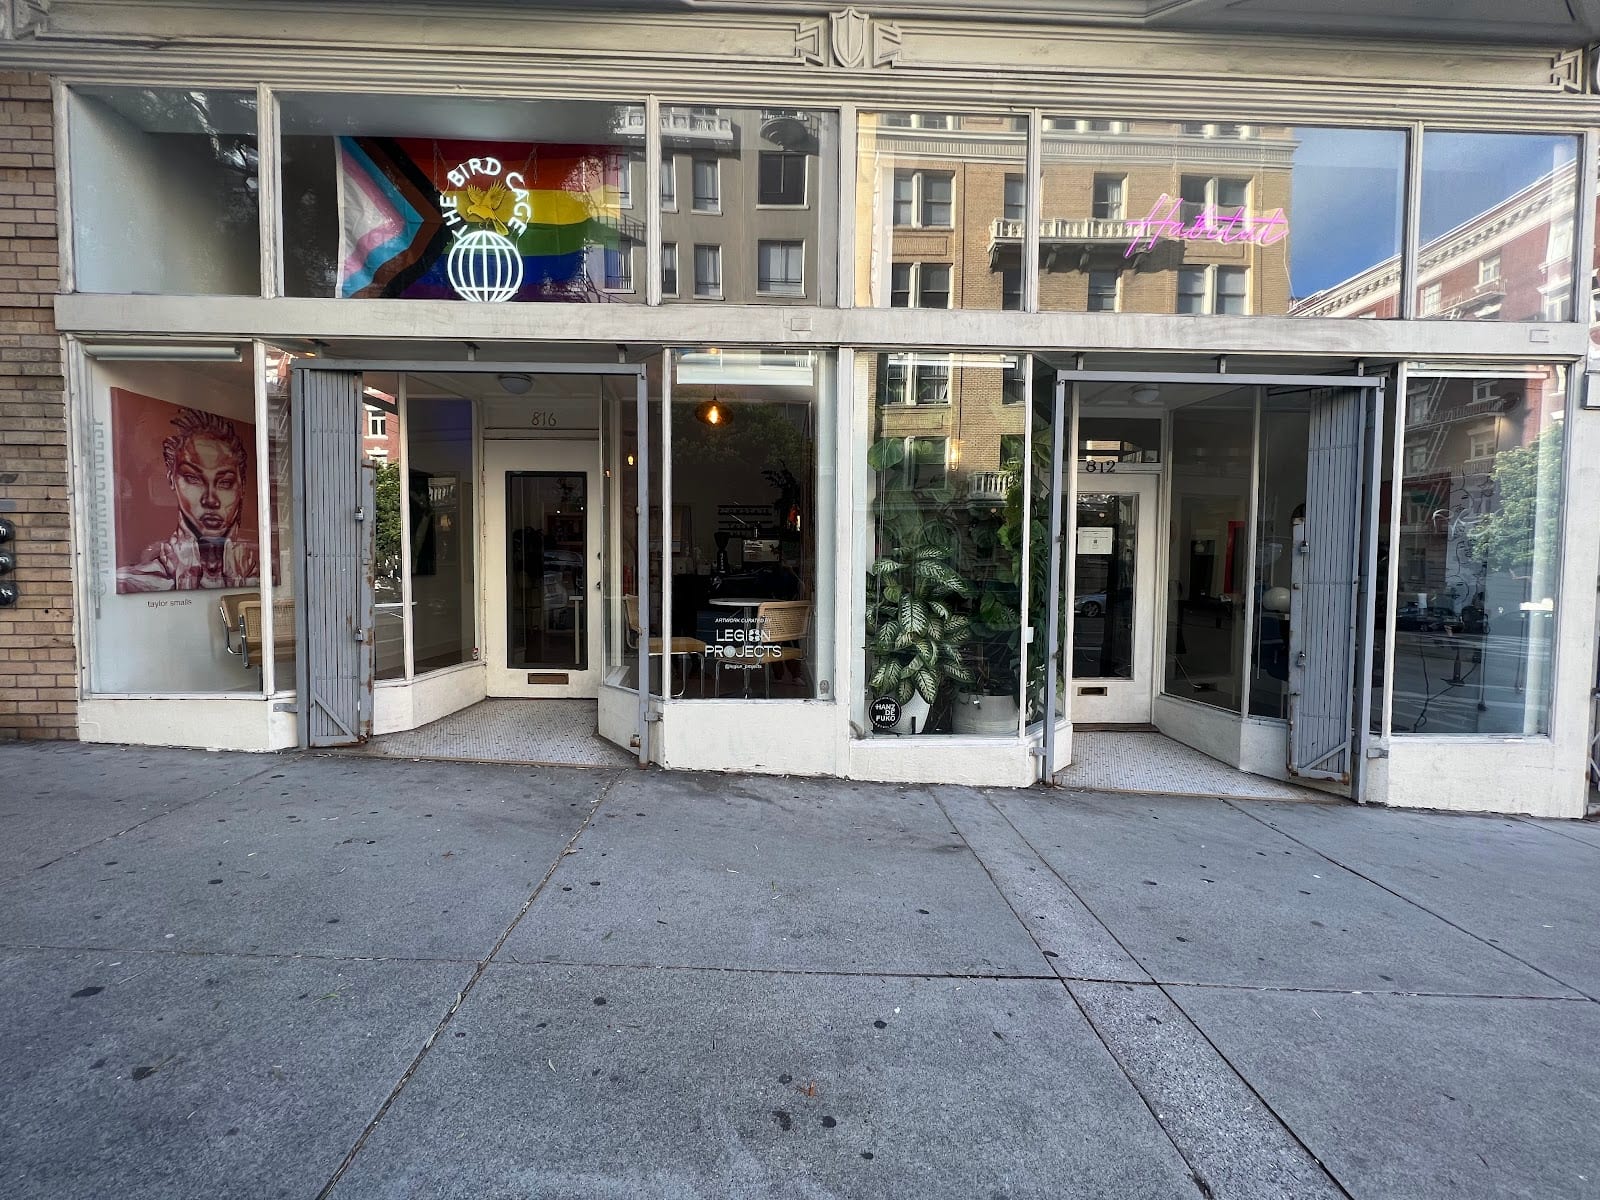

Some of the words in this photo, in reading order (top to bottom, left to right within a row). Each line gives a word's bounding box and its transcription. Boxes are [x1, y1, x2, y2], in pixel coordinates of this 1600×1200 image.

[447, 157, 501, 187] BIRD
[505, 171, 531, 237] CAGE
[440, 195, 468, 240] THE
[1126, 193, 1289, 257] Habitat
[531, 411, 557, 427] 816
[1086, 460, 1116, 473] 812
[147, 600, 168, 608] taylor
[716, 629, 771, 642] LEGION
[704, 645, 782, 658] PROJECTS
